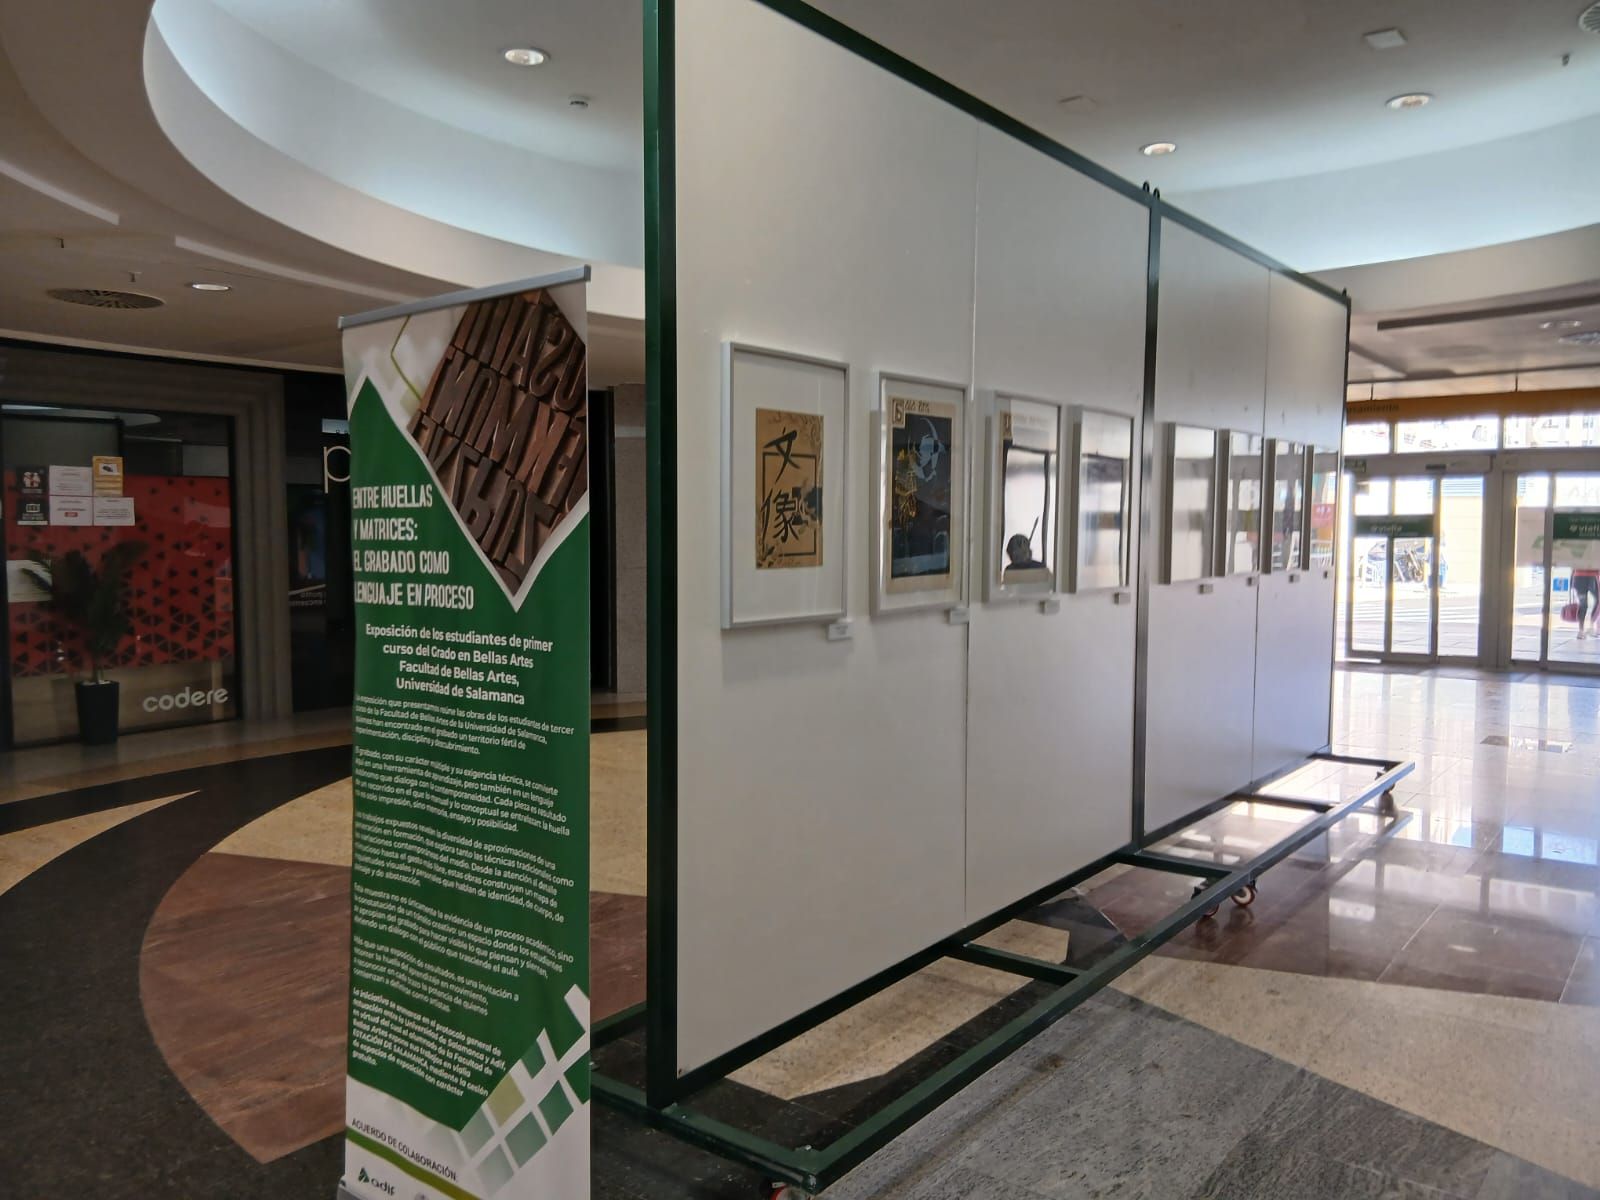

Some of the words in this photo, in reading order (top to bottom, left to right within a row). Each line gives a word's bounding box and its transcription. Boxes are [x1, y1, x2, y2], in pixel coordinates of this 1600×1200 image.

[353, 487, 379, 509] ENTRE
[381, 484, 433, 508] HUELLAS
[354, 520, 359, 541] Y
[360, 517, 418, 541] MATRICES:
[354, 551, 362, 572] EL
[364, 551, 416, 573] GRABADO
[420, 551, 449, 574] COMO
[355, 582, 403, 606] LENGUAJE
[407, 583, 423, 606] EN
[424, 584, 474, 610] PROCESO
[366, 624, 418, 639] Exposición
[420, 627, 431, 639] de
[432, 628, 444, 641] los
[445, 630, 507, 647] estudiantes
[509, 635, 522, 648] de
[523, 637, 553, 652] primer
[383, 645, 413, 656] curso
[416, 644, 430, 657] del
[458, 651, 471, 662] en
[473, 650, 507, 665] Bellas
[510, 653, 534, 669] Artes
[399, 661, 440, 676] Facultad
[441, 665, 452, 678] de
[454, 666, 484, 682] Bellas
[487, 670, 520, 688] Artes,
[143, 686, 229, 713] codere
[396, 677, 450, 696] Universidad
[452, 684, 464, 698] de
[466, 686, 525, 705] Salamanca
[380, 707, 409, 719] Facultad
[465, 721, 506, 735] Universidad
[388, 700, 402, 708] que
[466, 710, 484, 720] obras
[486, 712, 496, 721] de
[498, 713, 508, 723] los
[551, 724, 574, 735] tercer
[385, 720, 423, 732] encontrado
[469, 733, 500, 745] territorio
[501, 736, 516, 747] fértil
[382, 753, 394, 761] con
[464, 769, 496, 781] exigencia
[498, 773, 524, 788] técnica,
[384, 762, 423, 776] herramienta
[464, 781, 478, 790] pero
[480, 782, 511, 795] también
[380, 774, 392, 783] que
[494, 795, 513, 808] Cada
[514, 800, 530, 811] pieza
[413, 791, 424, 799] que
[461, 803, 499, 817] conceptual
[549, 823, 570, 836] huella
[449, 812, 471, 825] ensayo
[477, 818, 518, 832] posibilidad.
[484, 842, 536, 862] aproximaciones
[456, 846, 472, 858] tanto
[484, 853, 515, 868] técnicas
[553, 875, 574, 887] como
[471, 862, 493, 875] Desde
[503, 869, 532, 885] atención
[483, 877, 524, 894] construyen
[488, 889, 525, 909] identidad,
[468, 933, 491, 946] espacio
[493, 938, 518, 953] donde
[495, 928, 524, 943] proceso
[558, 952, 573, 962] sino
[447, 948, 458, 958] que
[502, 967, 520, 976] aula.
[476, 947, 488, 957] que
[489, 950, 519, 966] piensan
[466, 978, 478, 988] una
[479, 982, 512, 1000] invitación
[448, 1038, 484, 1062] Salamanca
[466, 1036, 492, 1052] general
[454, 1051, 483, 1072] Facultad
[467, 1082, 488, 1096] cesión
[351, 1118, 387, 1142] ACUERDO
[388, 1136, 398, 1148] DE
[371, 1178, 396, 1196] adif
